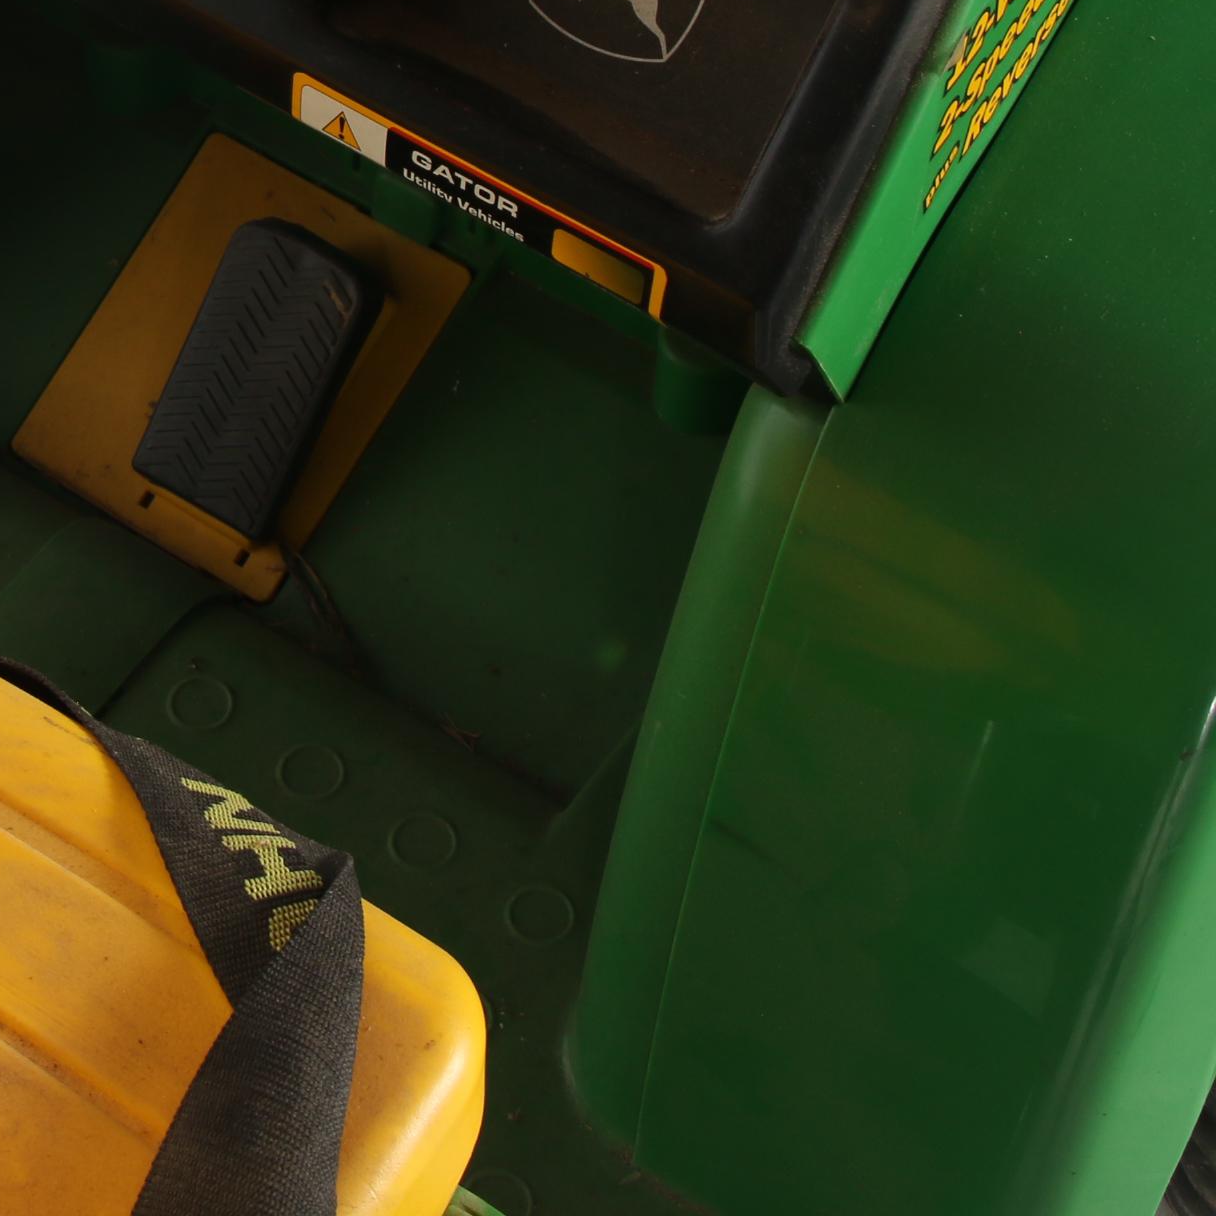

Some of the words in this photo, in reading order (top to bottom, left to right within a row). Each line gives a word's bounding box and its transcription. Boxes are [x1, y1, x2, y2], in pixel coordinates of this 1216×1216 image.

[402, 167, 454, 205] Utility
[456, 196, 526, 243] Vehicles
[410, 149, 520, 219] GATOR
